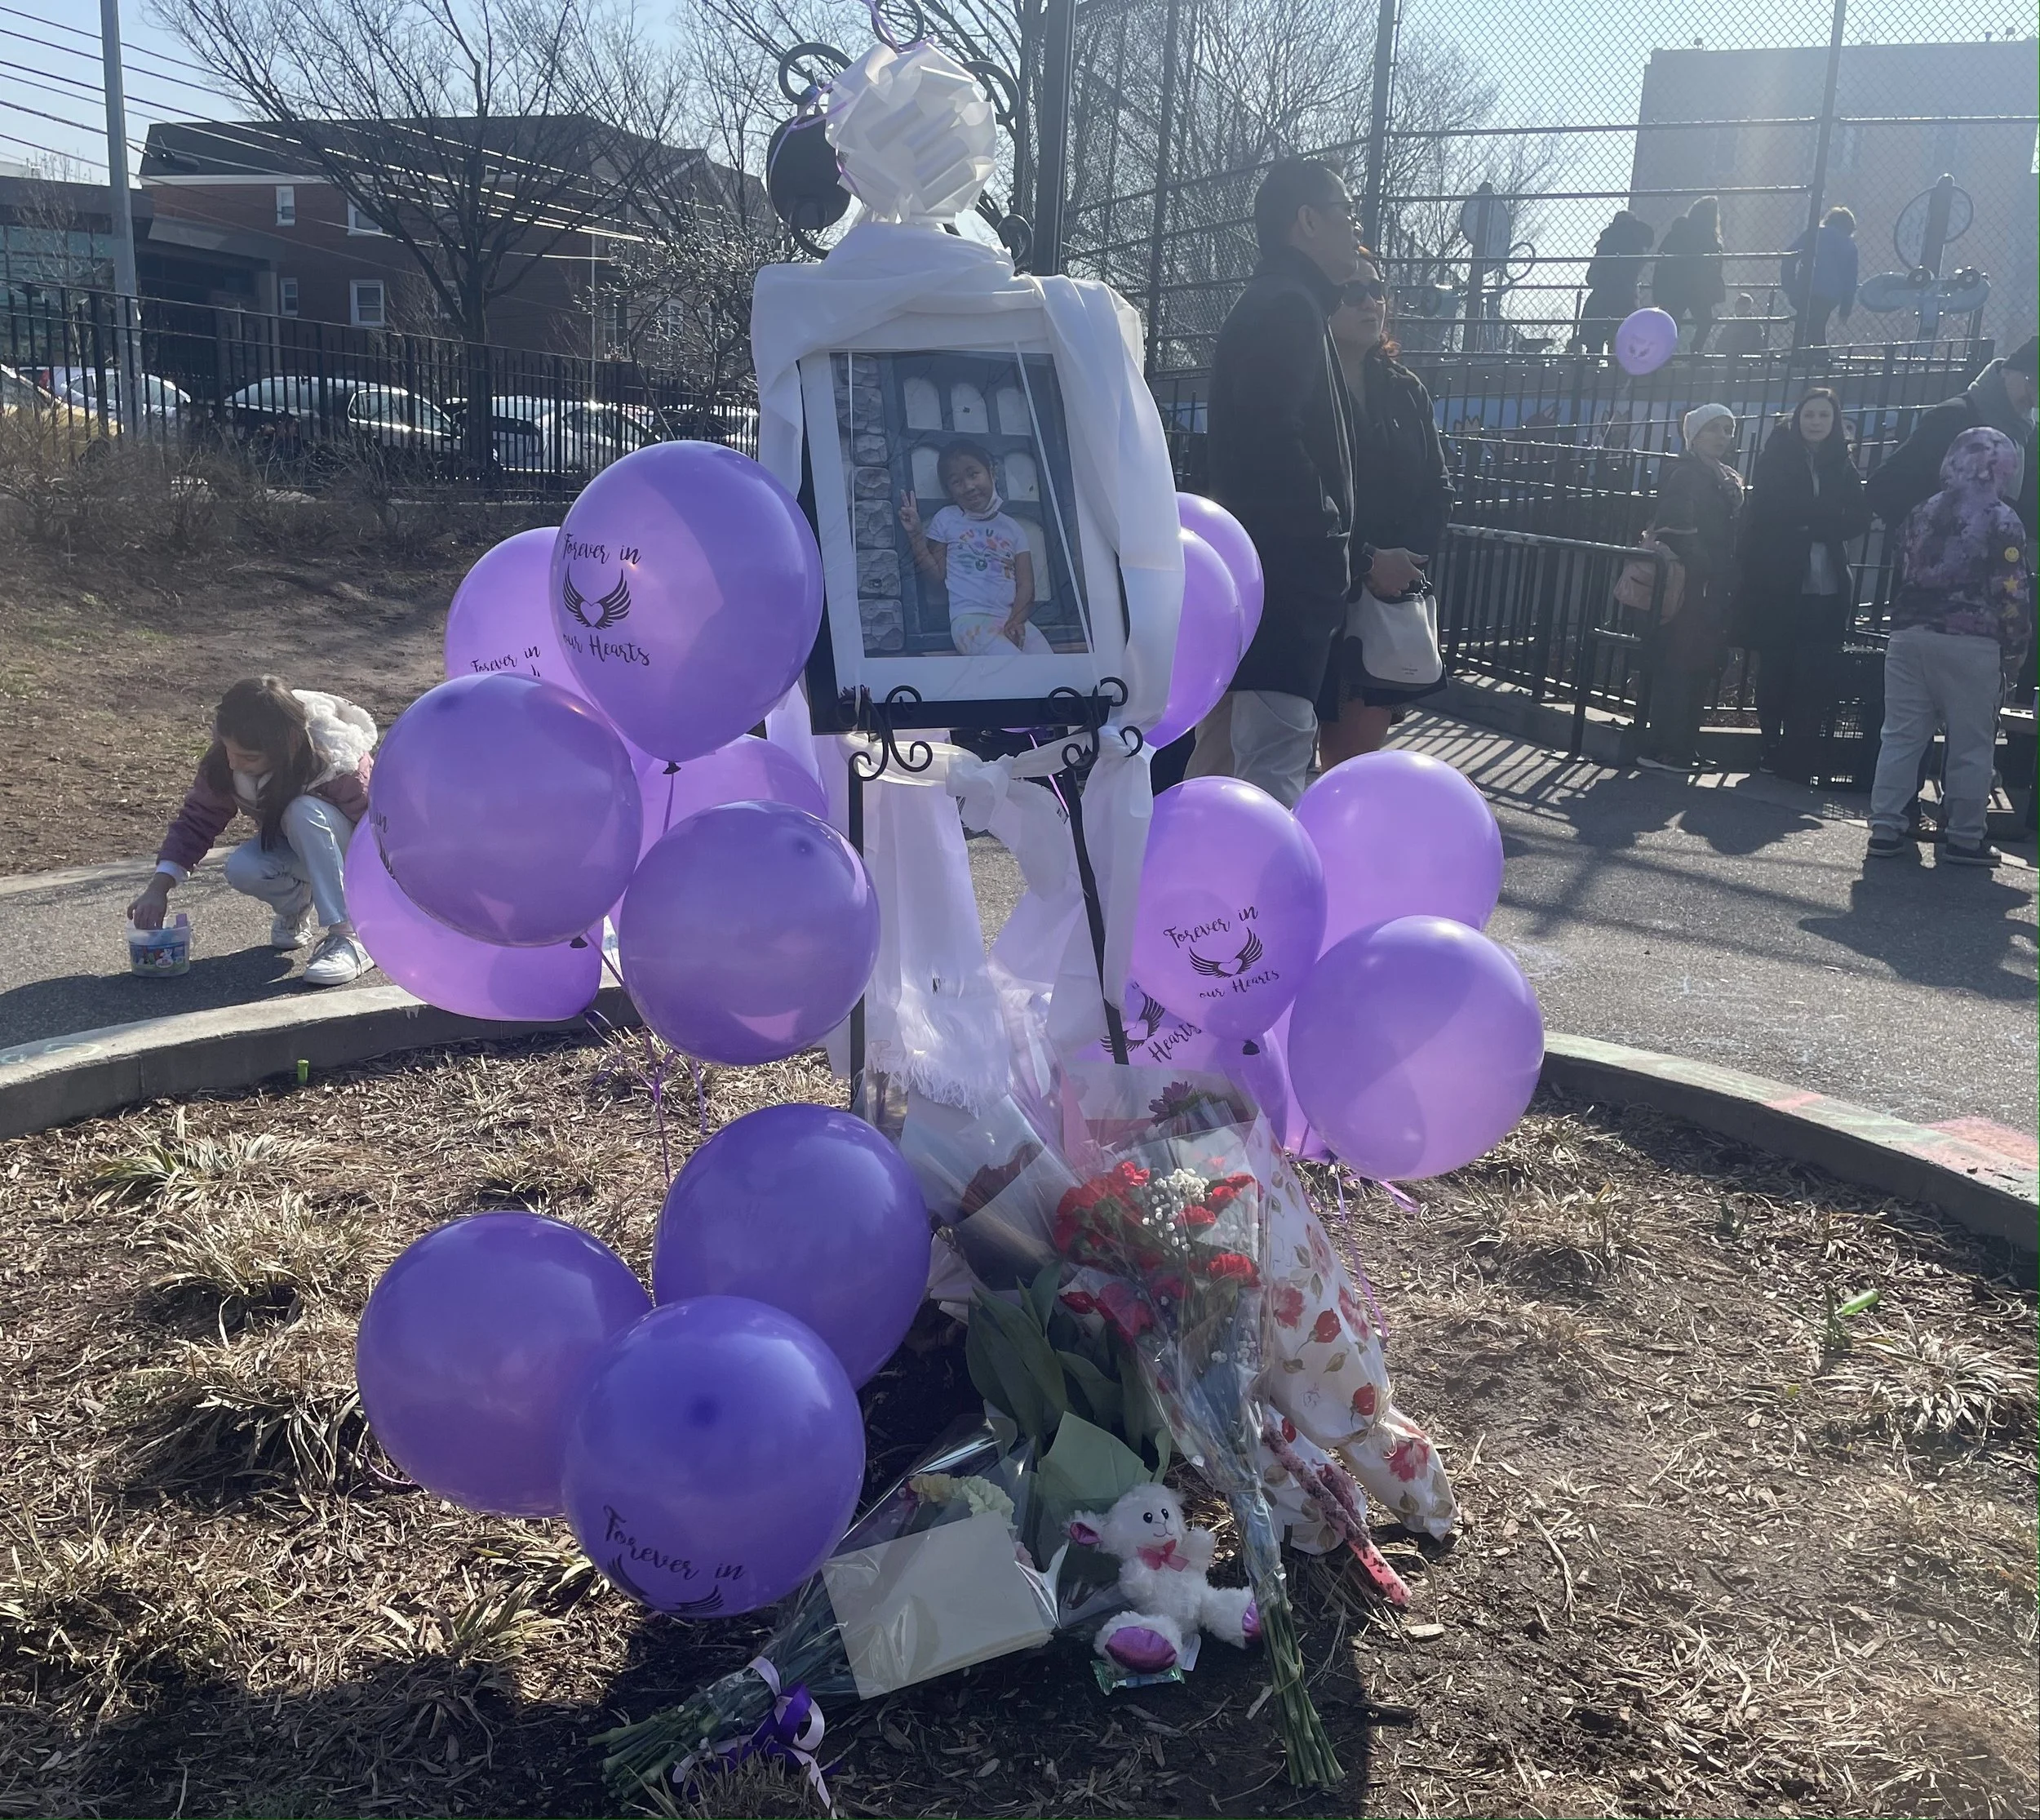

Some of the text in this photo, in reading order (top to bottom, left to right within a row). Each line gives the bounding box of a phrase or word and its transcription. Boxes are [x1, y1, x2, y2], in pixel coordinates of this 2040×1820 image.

[562, 533, 642, 565] Forever in
[470, 646, 541, 673] Forever in
[562, 633, 650, 667] our Hearts
[1163, 906, 1258, 948] Forever in
[1199, 970, 1279, 999] our Hearts
[1147, 1022, 1202, 1063] Hearts
[603, 1504, 746, 1581] Forever in
